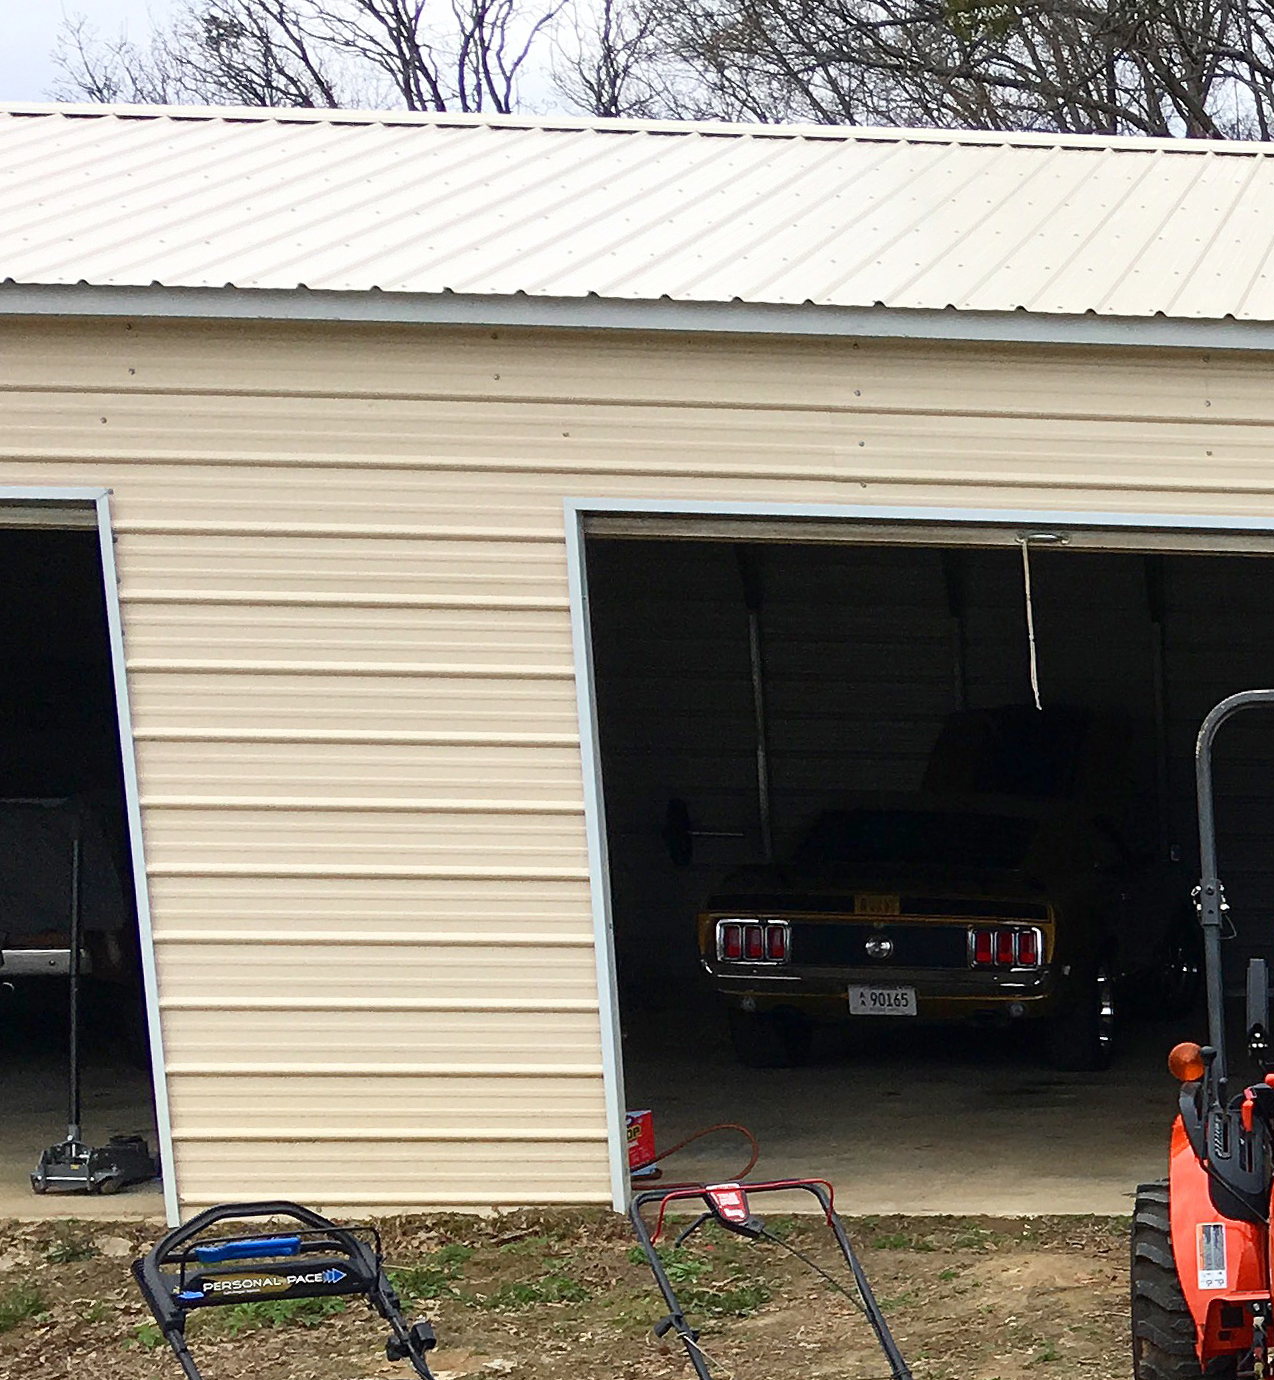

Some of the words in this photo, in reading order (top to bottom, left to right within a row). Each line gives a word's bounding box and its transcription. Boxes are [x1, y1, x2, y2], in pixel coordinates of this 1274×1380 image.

[869, 991, 909, 1008] 90165
[202, 1277, 282, 1293] PERSONAL
[286, 1272, 323, 1286] PACE
